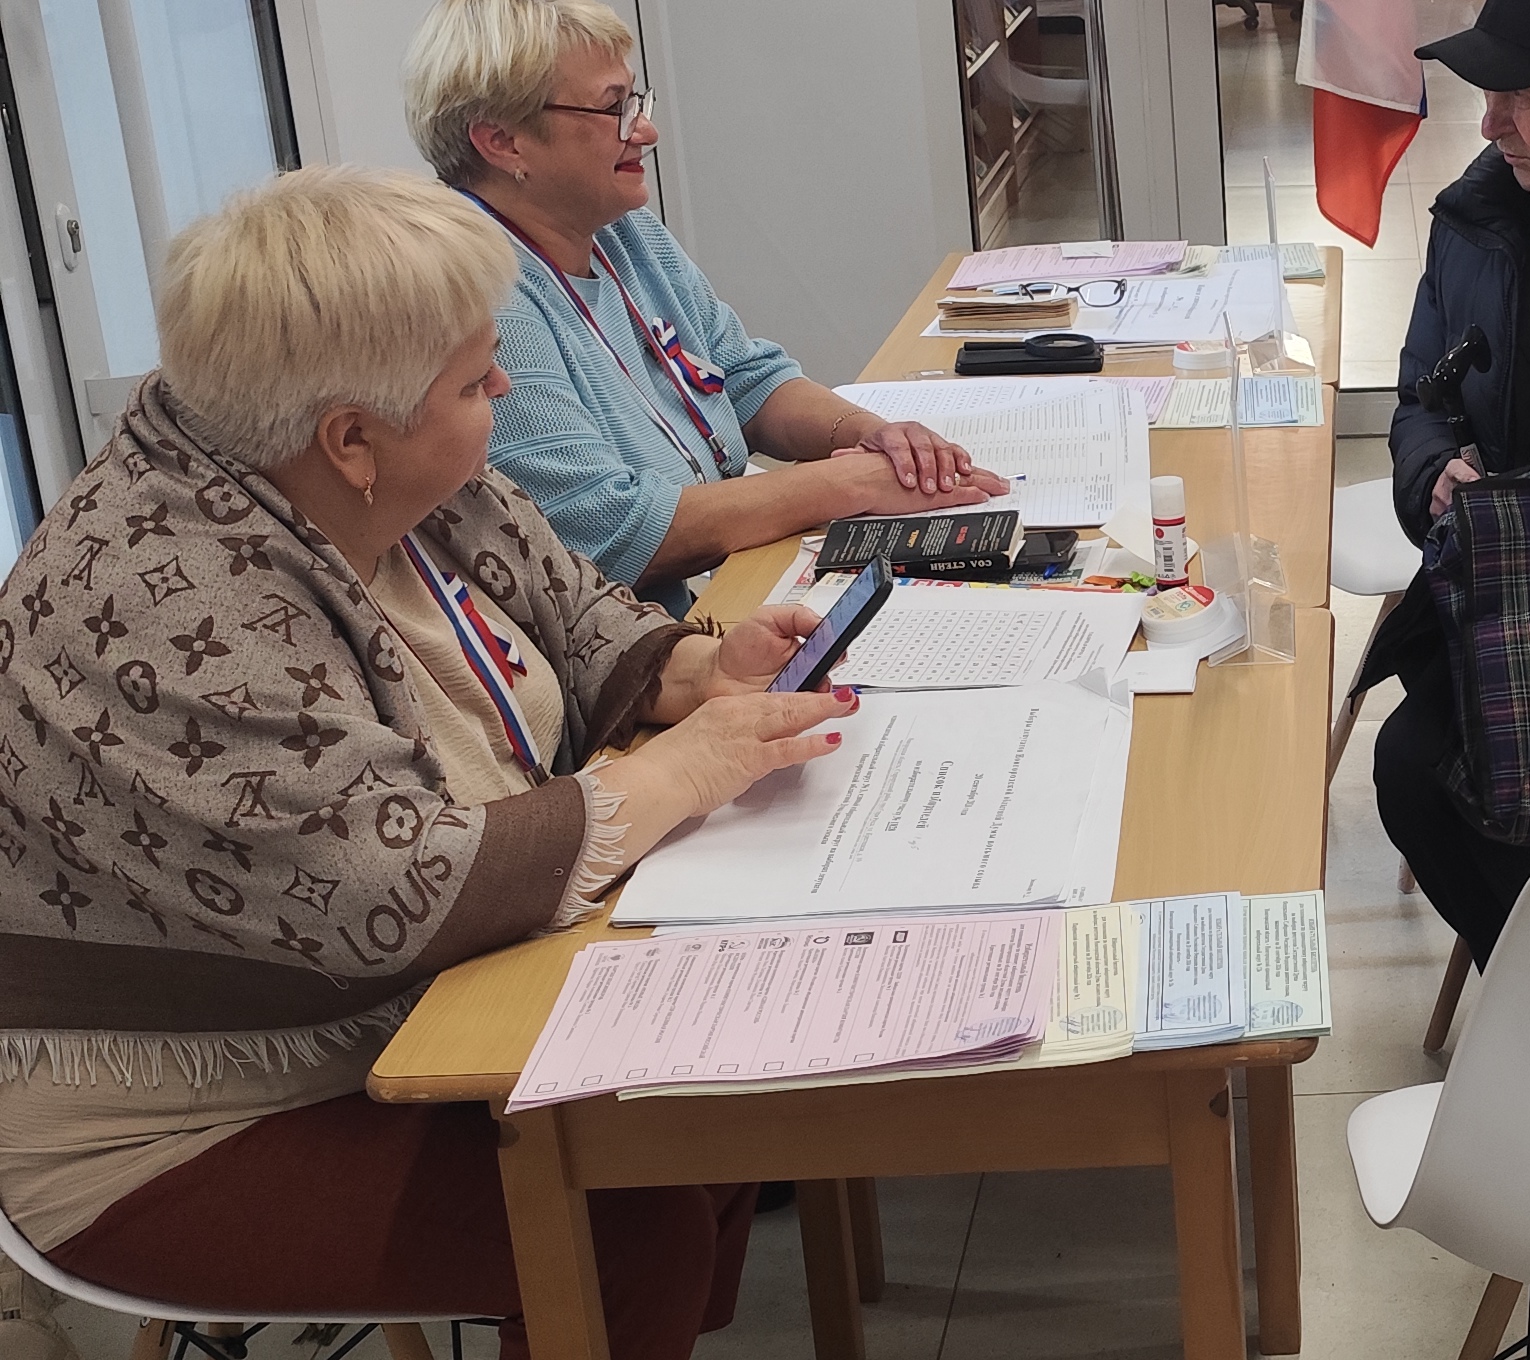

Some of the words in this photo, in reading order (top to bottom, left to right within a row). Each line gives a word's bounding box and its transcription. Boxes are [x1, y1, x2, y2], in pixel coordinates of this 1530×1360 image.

[930, 561, 966, 572] СТЕЙН
[970, 558, 993, 568] СОЛ
[933, 760, 953, 789] Список
[1004, 753, 1024, 794] Новгородской
[915, 791, 941, 828] избирателей
[988, 821, 1002, 838] Думы
[337, 851, 452, 968] LOUIS
